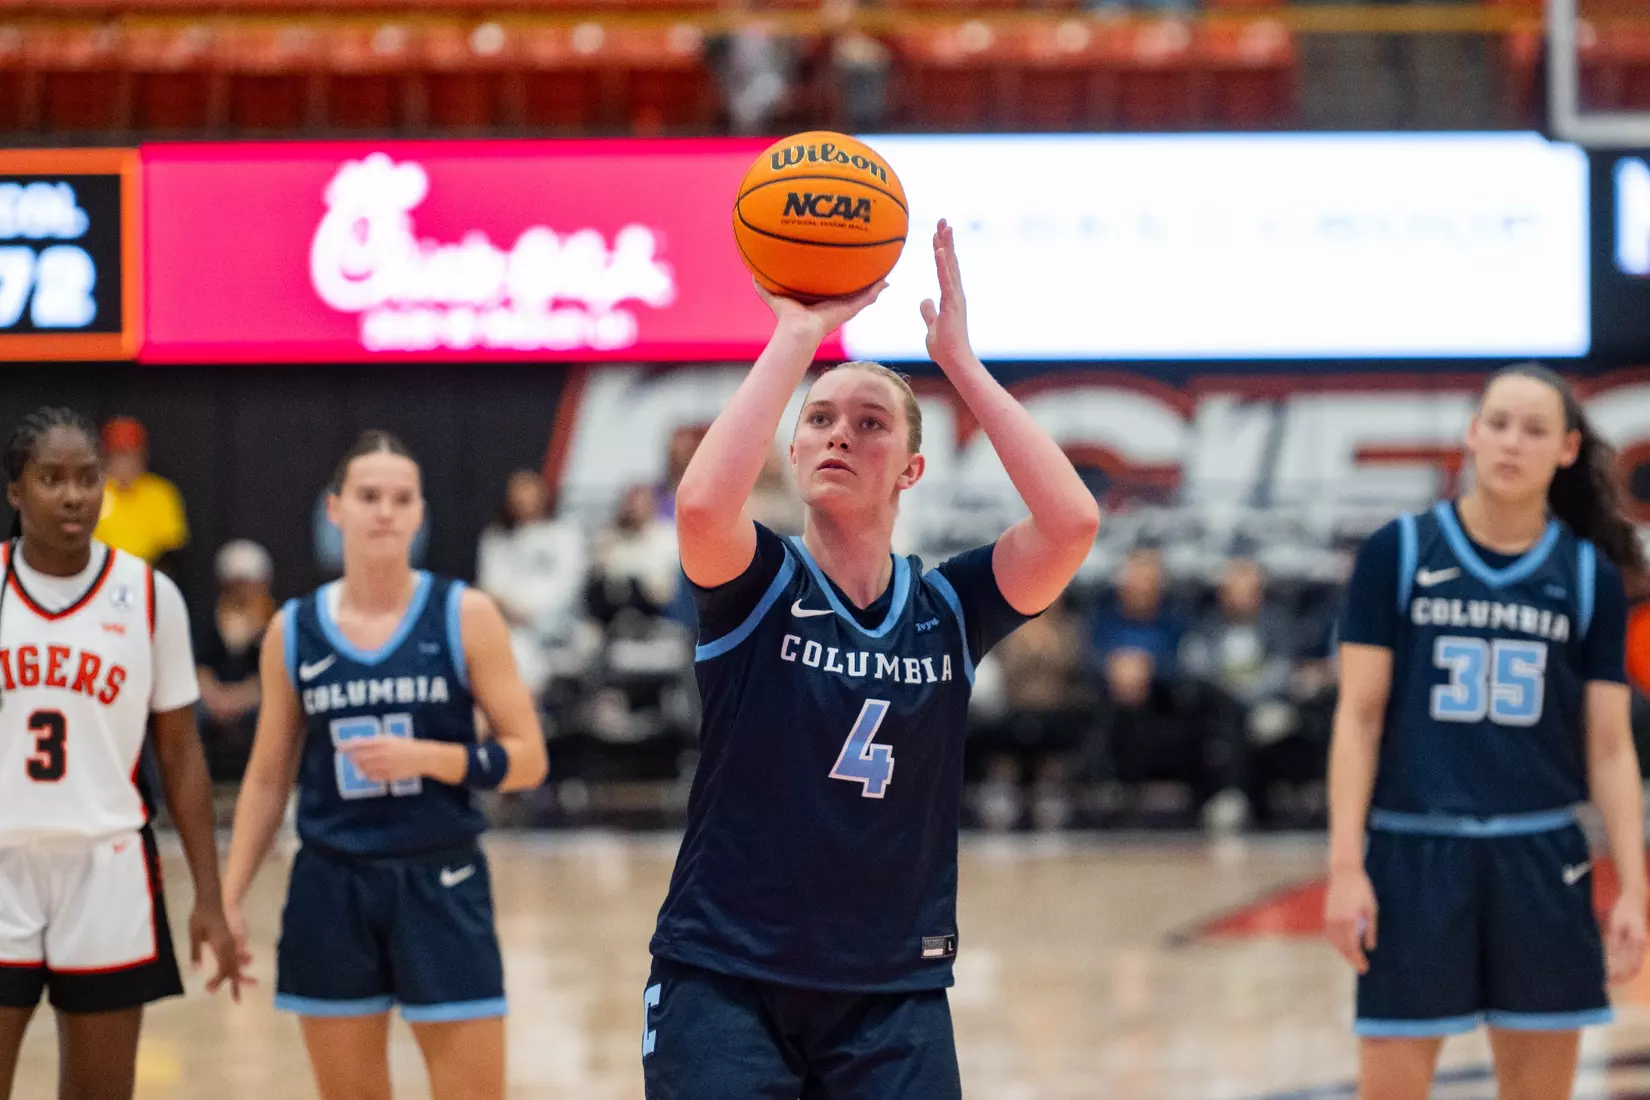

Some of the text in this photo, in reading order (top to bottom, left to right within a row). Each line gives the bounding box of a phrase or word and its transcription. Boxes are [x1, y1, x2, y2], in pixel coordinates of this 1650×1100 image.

[770, 143, 889, 185] Wilson
[782, 192, 872, 224] NCAA
[1411, 597, 1571, 643] COLUMBIA
[0, 645, 127, 705] IGERS
[780, 634, 952, 684] COLUMBIA
[1429, 635, 1549, 728] 35
[302, 675, 450, 716] COLUMBIA
[26, 708, 67, 783] 3
[828, 698, 895, 799] 4
